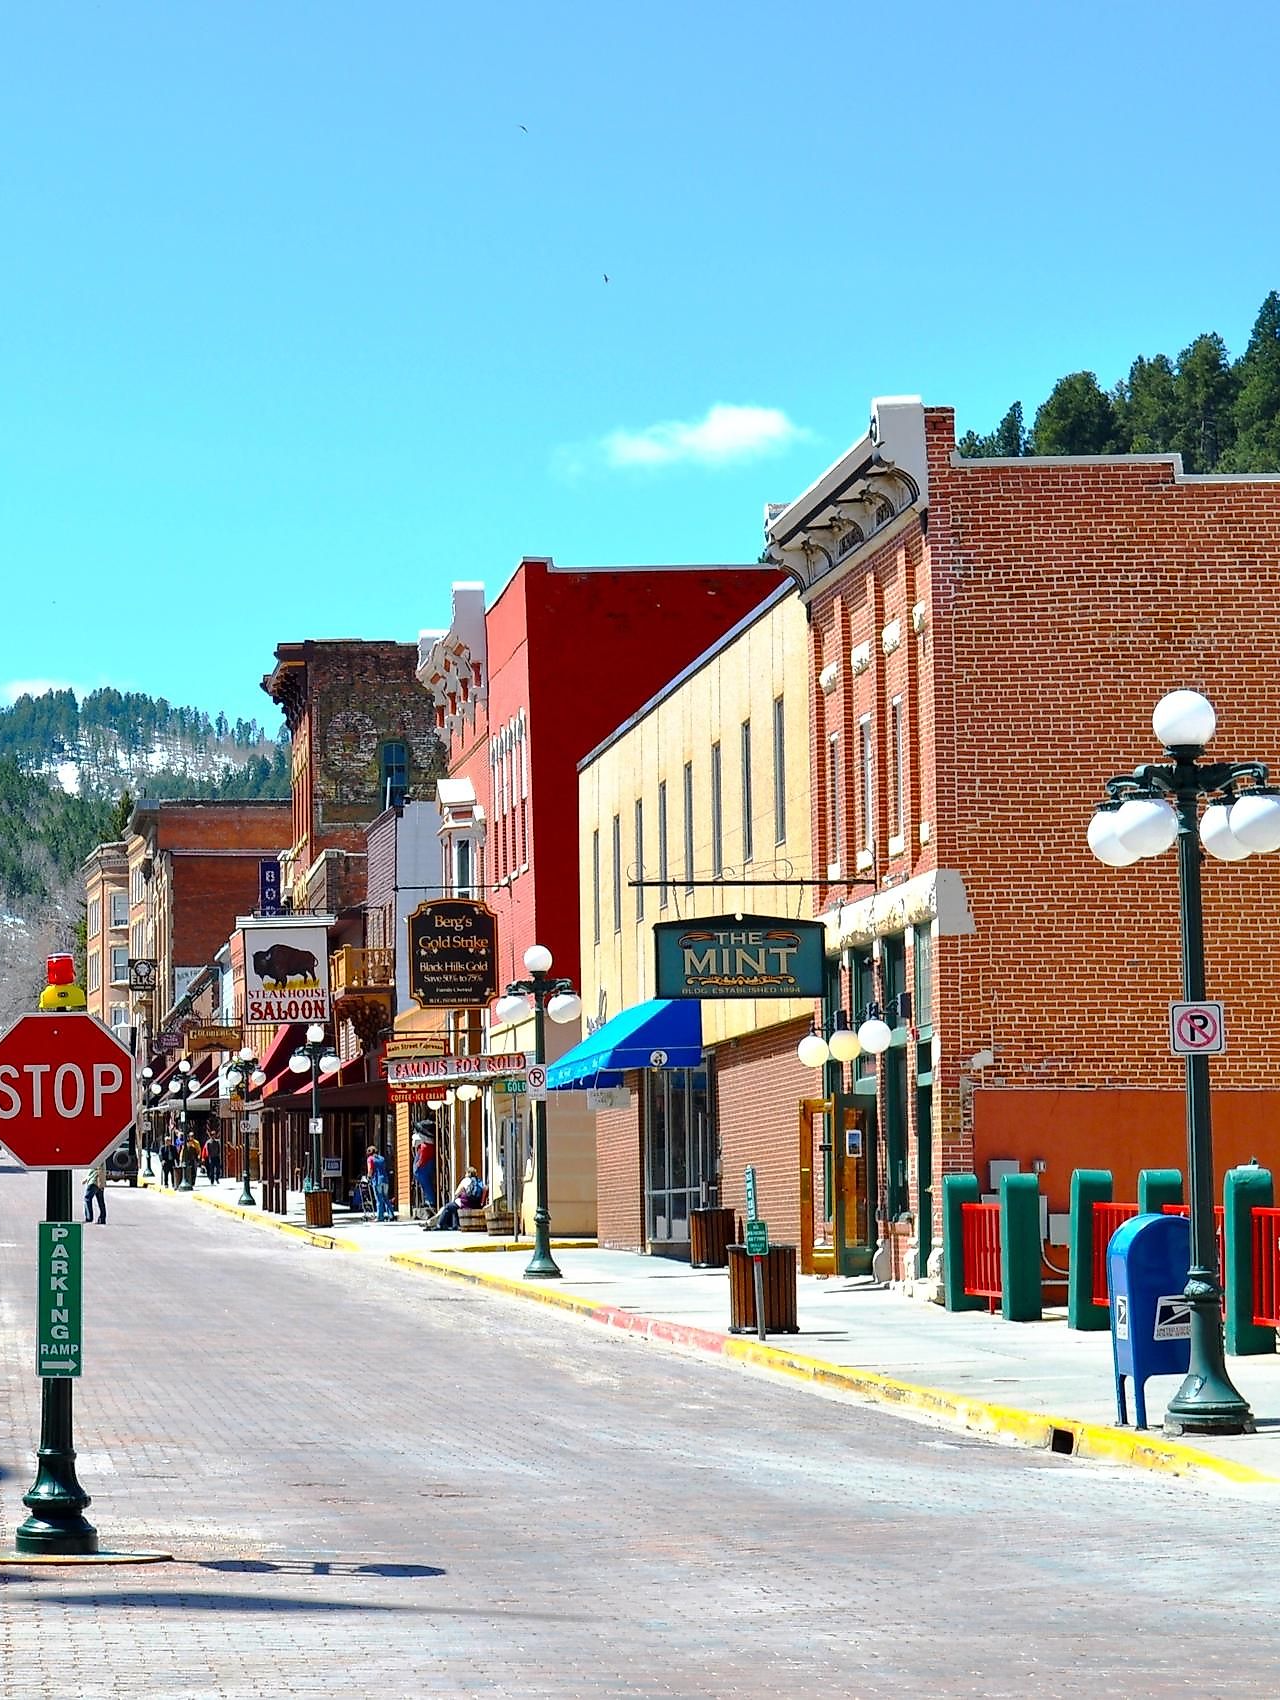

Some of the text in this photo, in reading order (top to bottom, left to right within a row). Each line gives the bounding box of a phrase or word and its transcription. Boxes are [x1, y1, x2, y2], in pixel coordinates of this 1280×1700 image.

[434, 915, 473, 931] Berg's
[419, 936, 489, 948] Gold Strike
[714, 932, 763, 945] THE
[419, 961, 488, 972] Black Hills Gold
[683, 948, 798, 975] MINT
[131, 976, 155, 986] ELKS
[424, 974, 442, 982] Save
[248, 989, 327, 999] STEAKHOUSE
[712, 986, 777, 994] ESTABLISHED
[250, 1000, 327, 1021] SALOON
[394, 1061, 448, 1078] FAMOUS
[455, 1057, 481, 1074] FOR
[486, 1054, 526, 1071] GOLD
[507, 1081, 527, 1092] GOLD
[391, 1094, 412, 1102] COFFEE
[425, 1092, 445, 1100] CREAM
[51, 1227, 70, 1340] PARKING
[40, 1344, 79, 1355] RAMP
